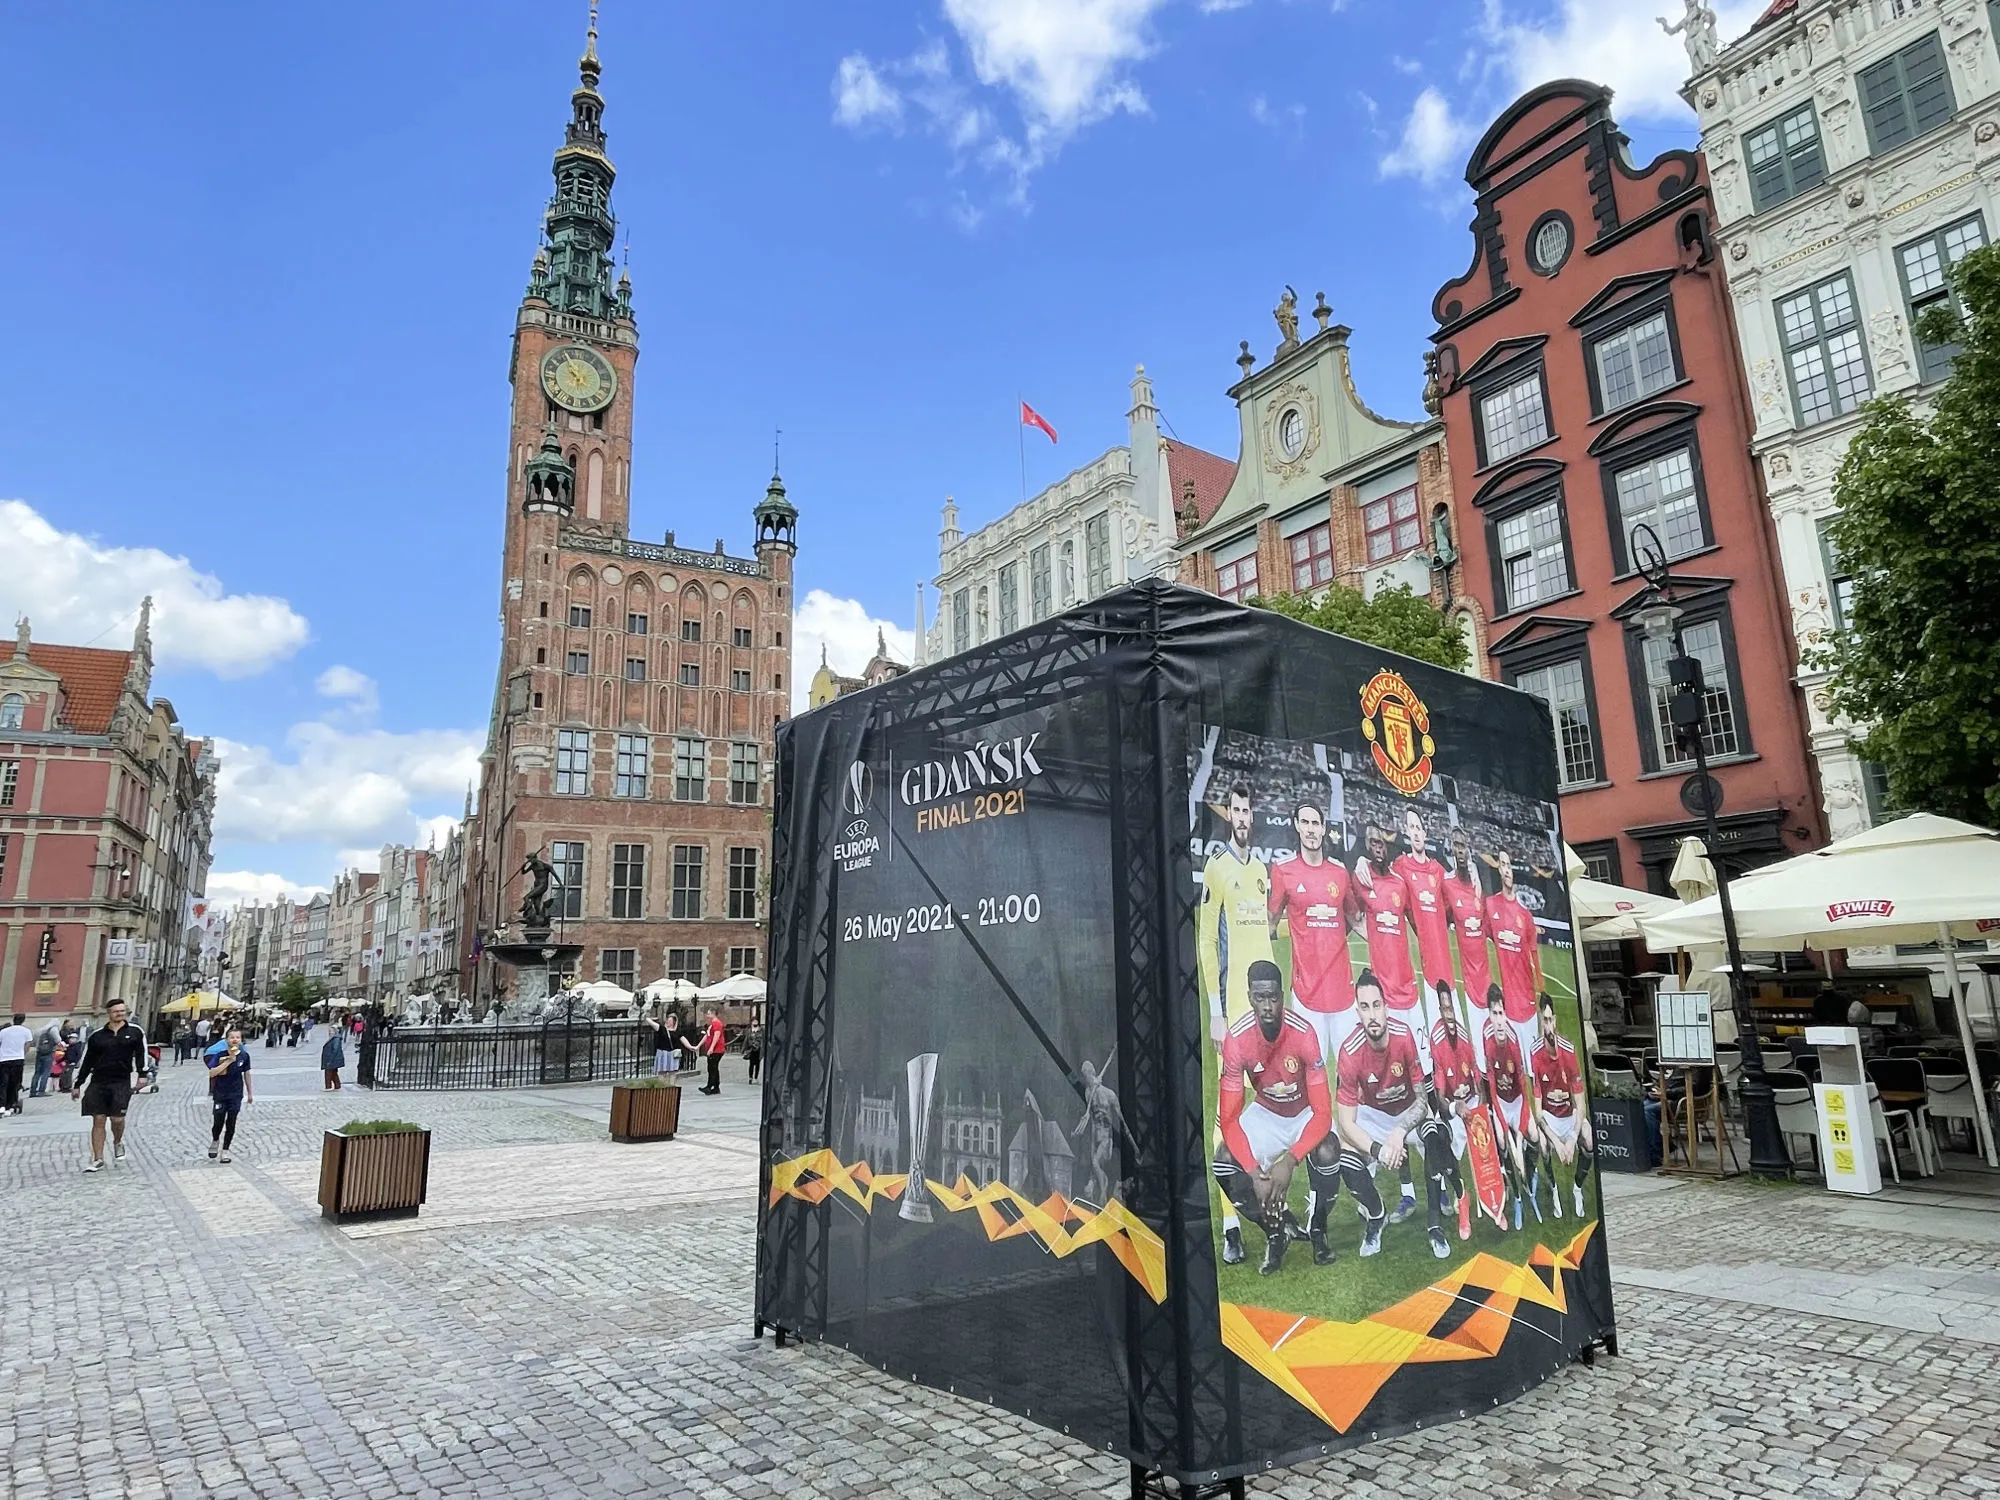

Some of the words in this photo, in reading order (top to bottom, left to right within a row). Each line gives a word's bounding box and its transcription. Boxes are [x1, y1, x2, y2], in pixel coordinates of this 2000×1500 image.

[1365, 677, 1424, 726] MANCHESTER
[900, 732, 1043, 806] GDAŃSK
[1384, 762, 1424, 789] UNITED
[917, 801, 970, 834] FINAL
[974, 788, 1025, 820] 2021
[846, 822, 868, 837] UEFA
[833, 836, 880, 860] EUROPA
[843, 856, 872, 872] LEAGUE
[844, 916, 863, 942] 26
[867, 913, 903, 942] May
[906, 903, 955, 934] 2021
[978, 893, 1041, 926] 21:00
[1833, 900, 1887, 916] ŻYWIEC
[1596, 1129, 1609, 1140] TO
